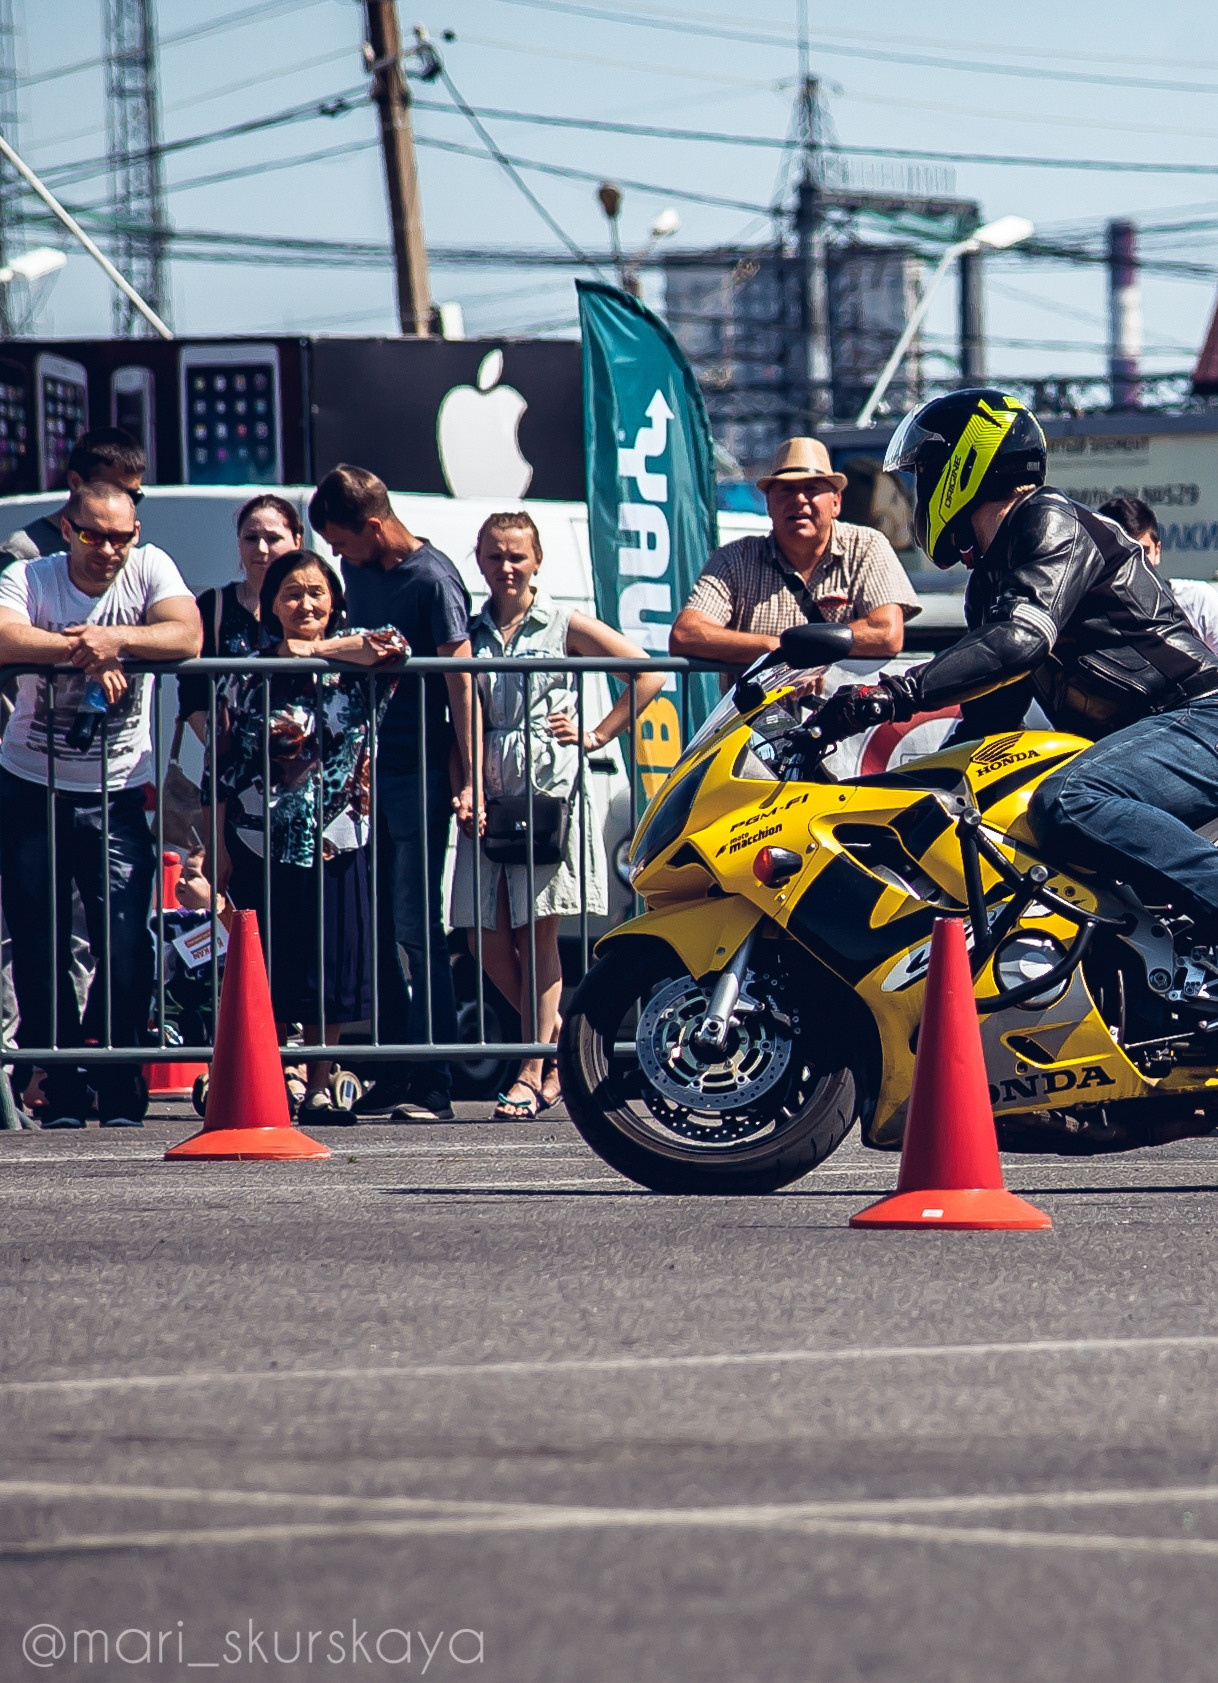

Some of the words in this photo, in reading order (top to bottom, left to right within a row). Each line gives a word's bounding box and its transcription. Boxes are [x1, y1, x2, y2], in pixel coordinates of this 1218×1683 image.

[944, 454, 962, 509] ORIGINE
[975, 749, 1041, 777] HONDA
[730, 792, 809, 832] PGM-FI
[729, 823, 783, 854] macchion
[730, 832, 749, 845] moto
[989, 1065, 1116, 1103] NDA
